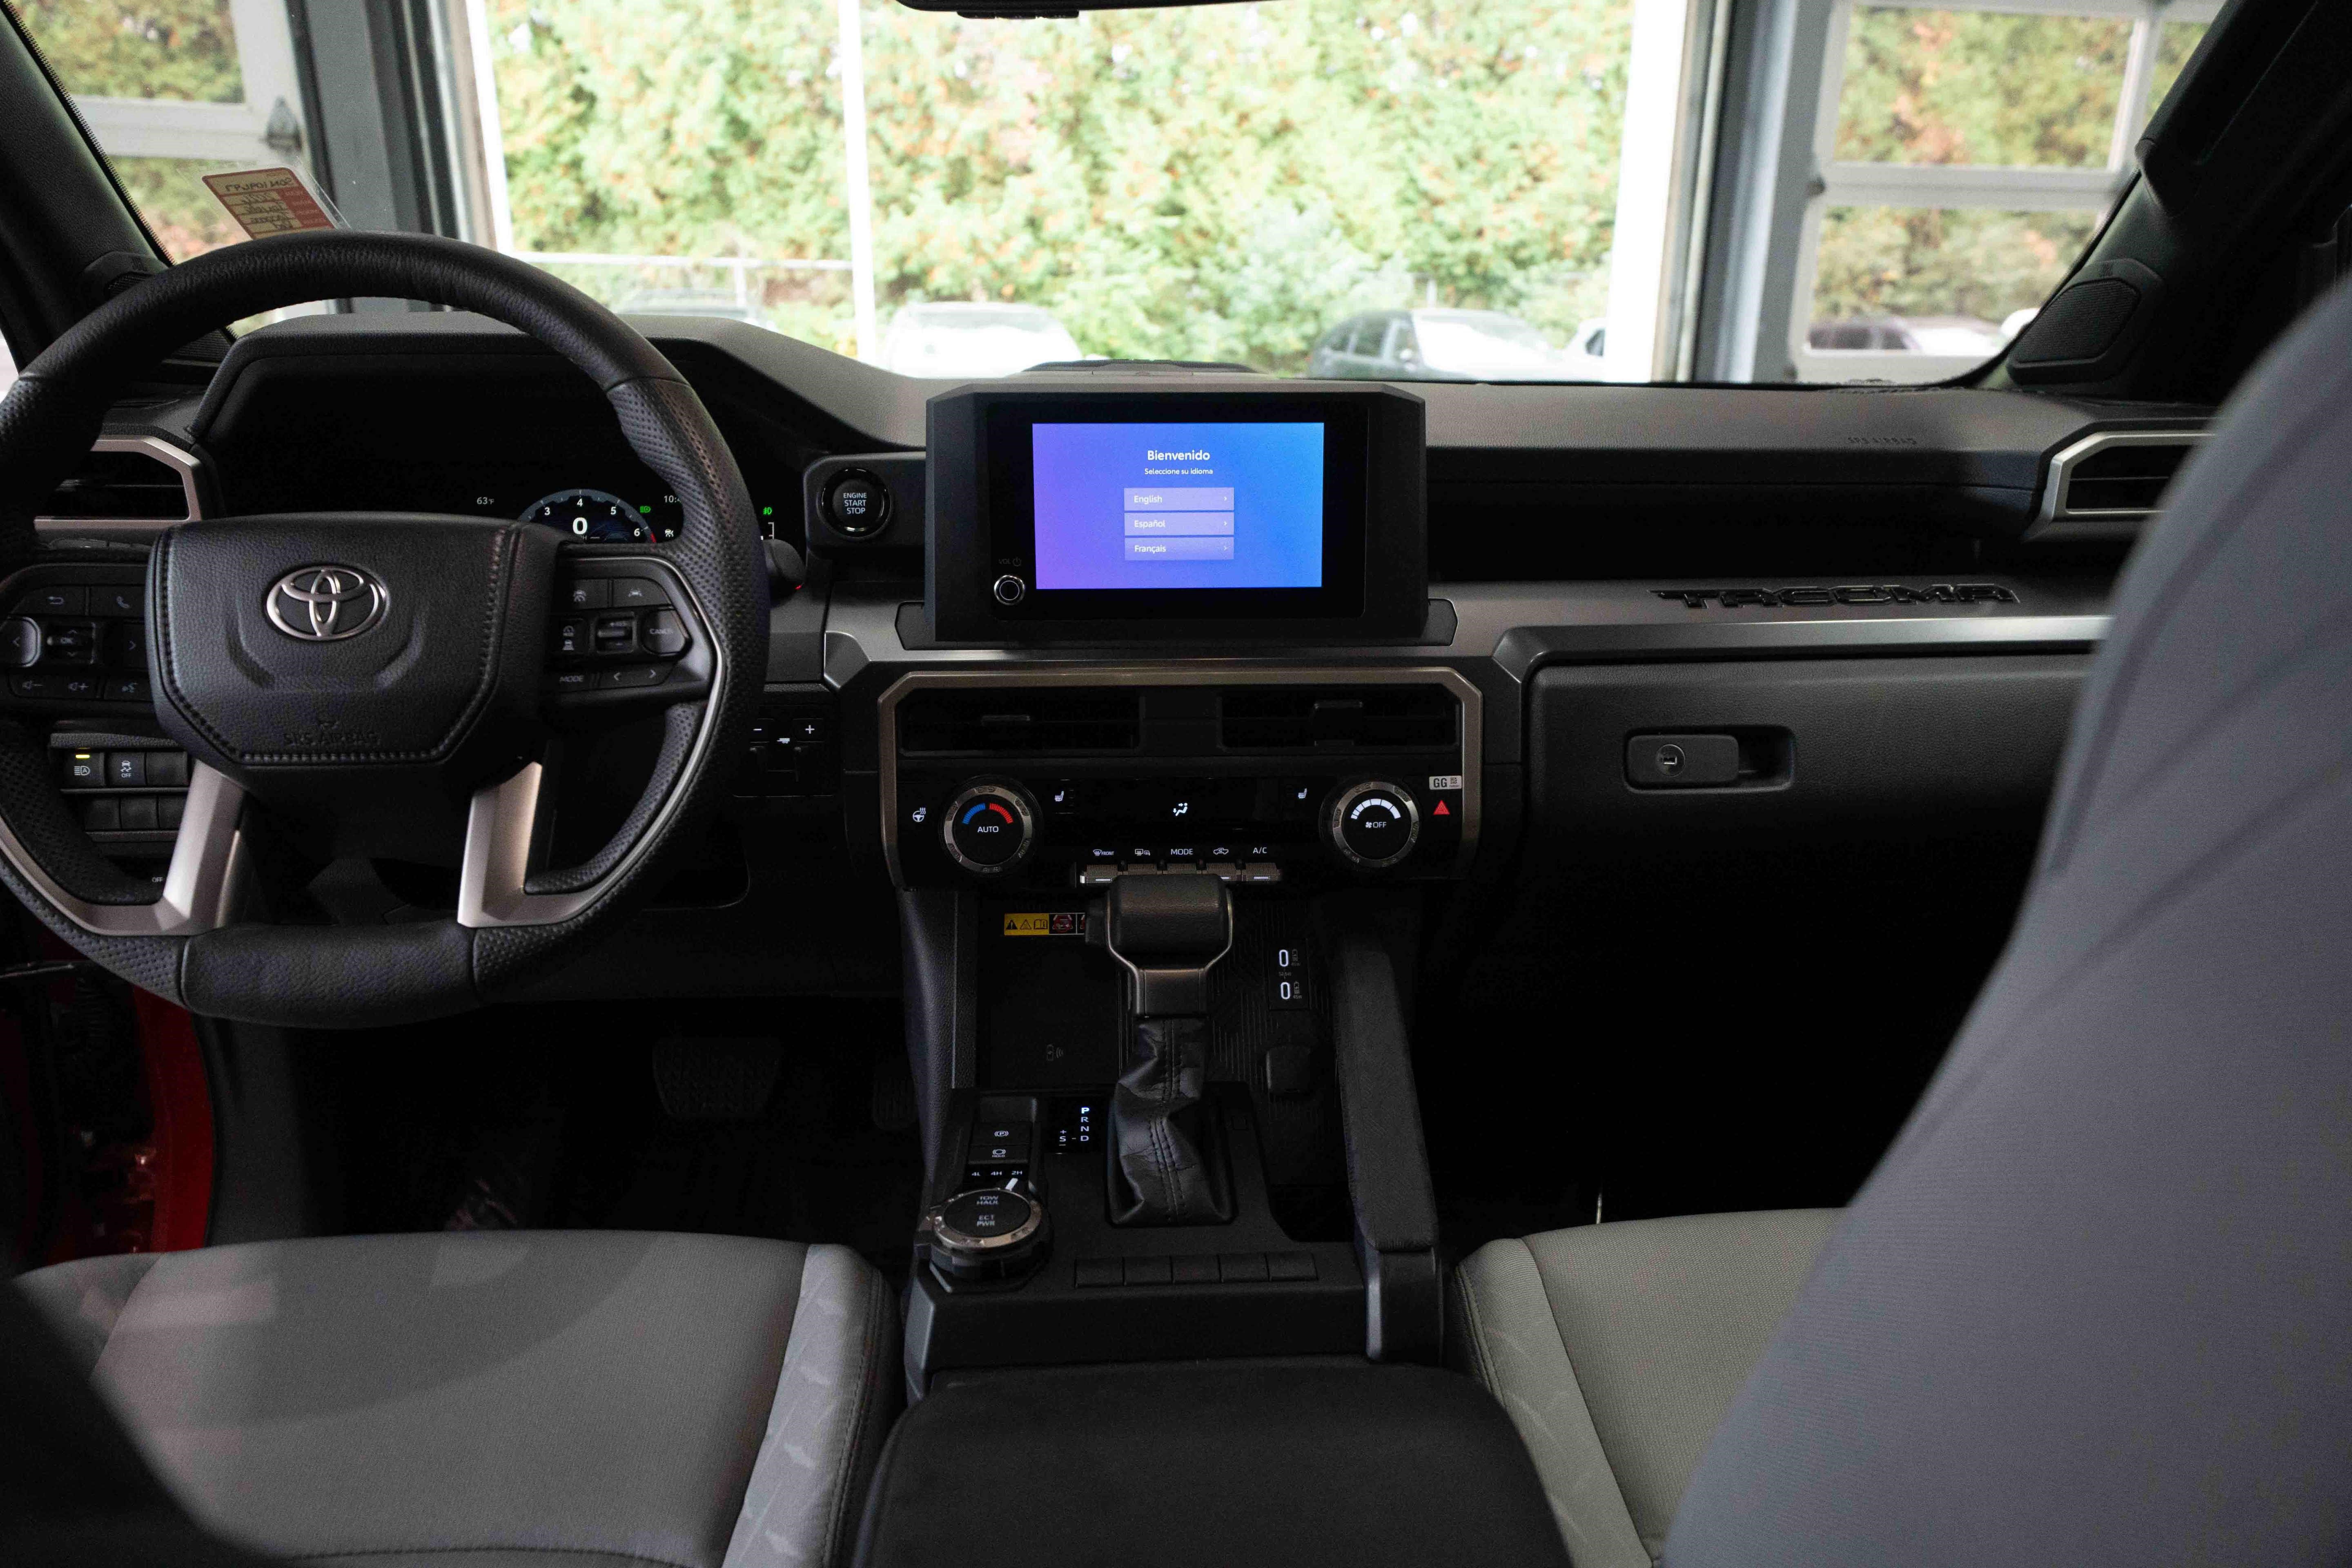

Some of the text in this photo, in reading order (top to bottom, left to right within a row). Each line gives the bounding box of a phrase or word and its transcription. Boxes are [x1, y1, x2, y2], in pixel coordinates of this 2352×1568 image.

[1147, 450, 1210, 461] Bienvenido
[577, 499, 583, 507] 4
[1134, 495, 1162, 505] English
[544, 507, 550, 515] 3
[610, 507, 617, 515] 5
[572, 517, 588, 535] 0
[1134, 520, 1165, 530] Español
[633, 528, 640, 537] 6
[1134, 545, 1166, 554] Français
[1648, 584, 2020, 608] TACOMA
[1434, 778, 1447, 788] GG
